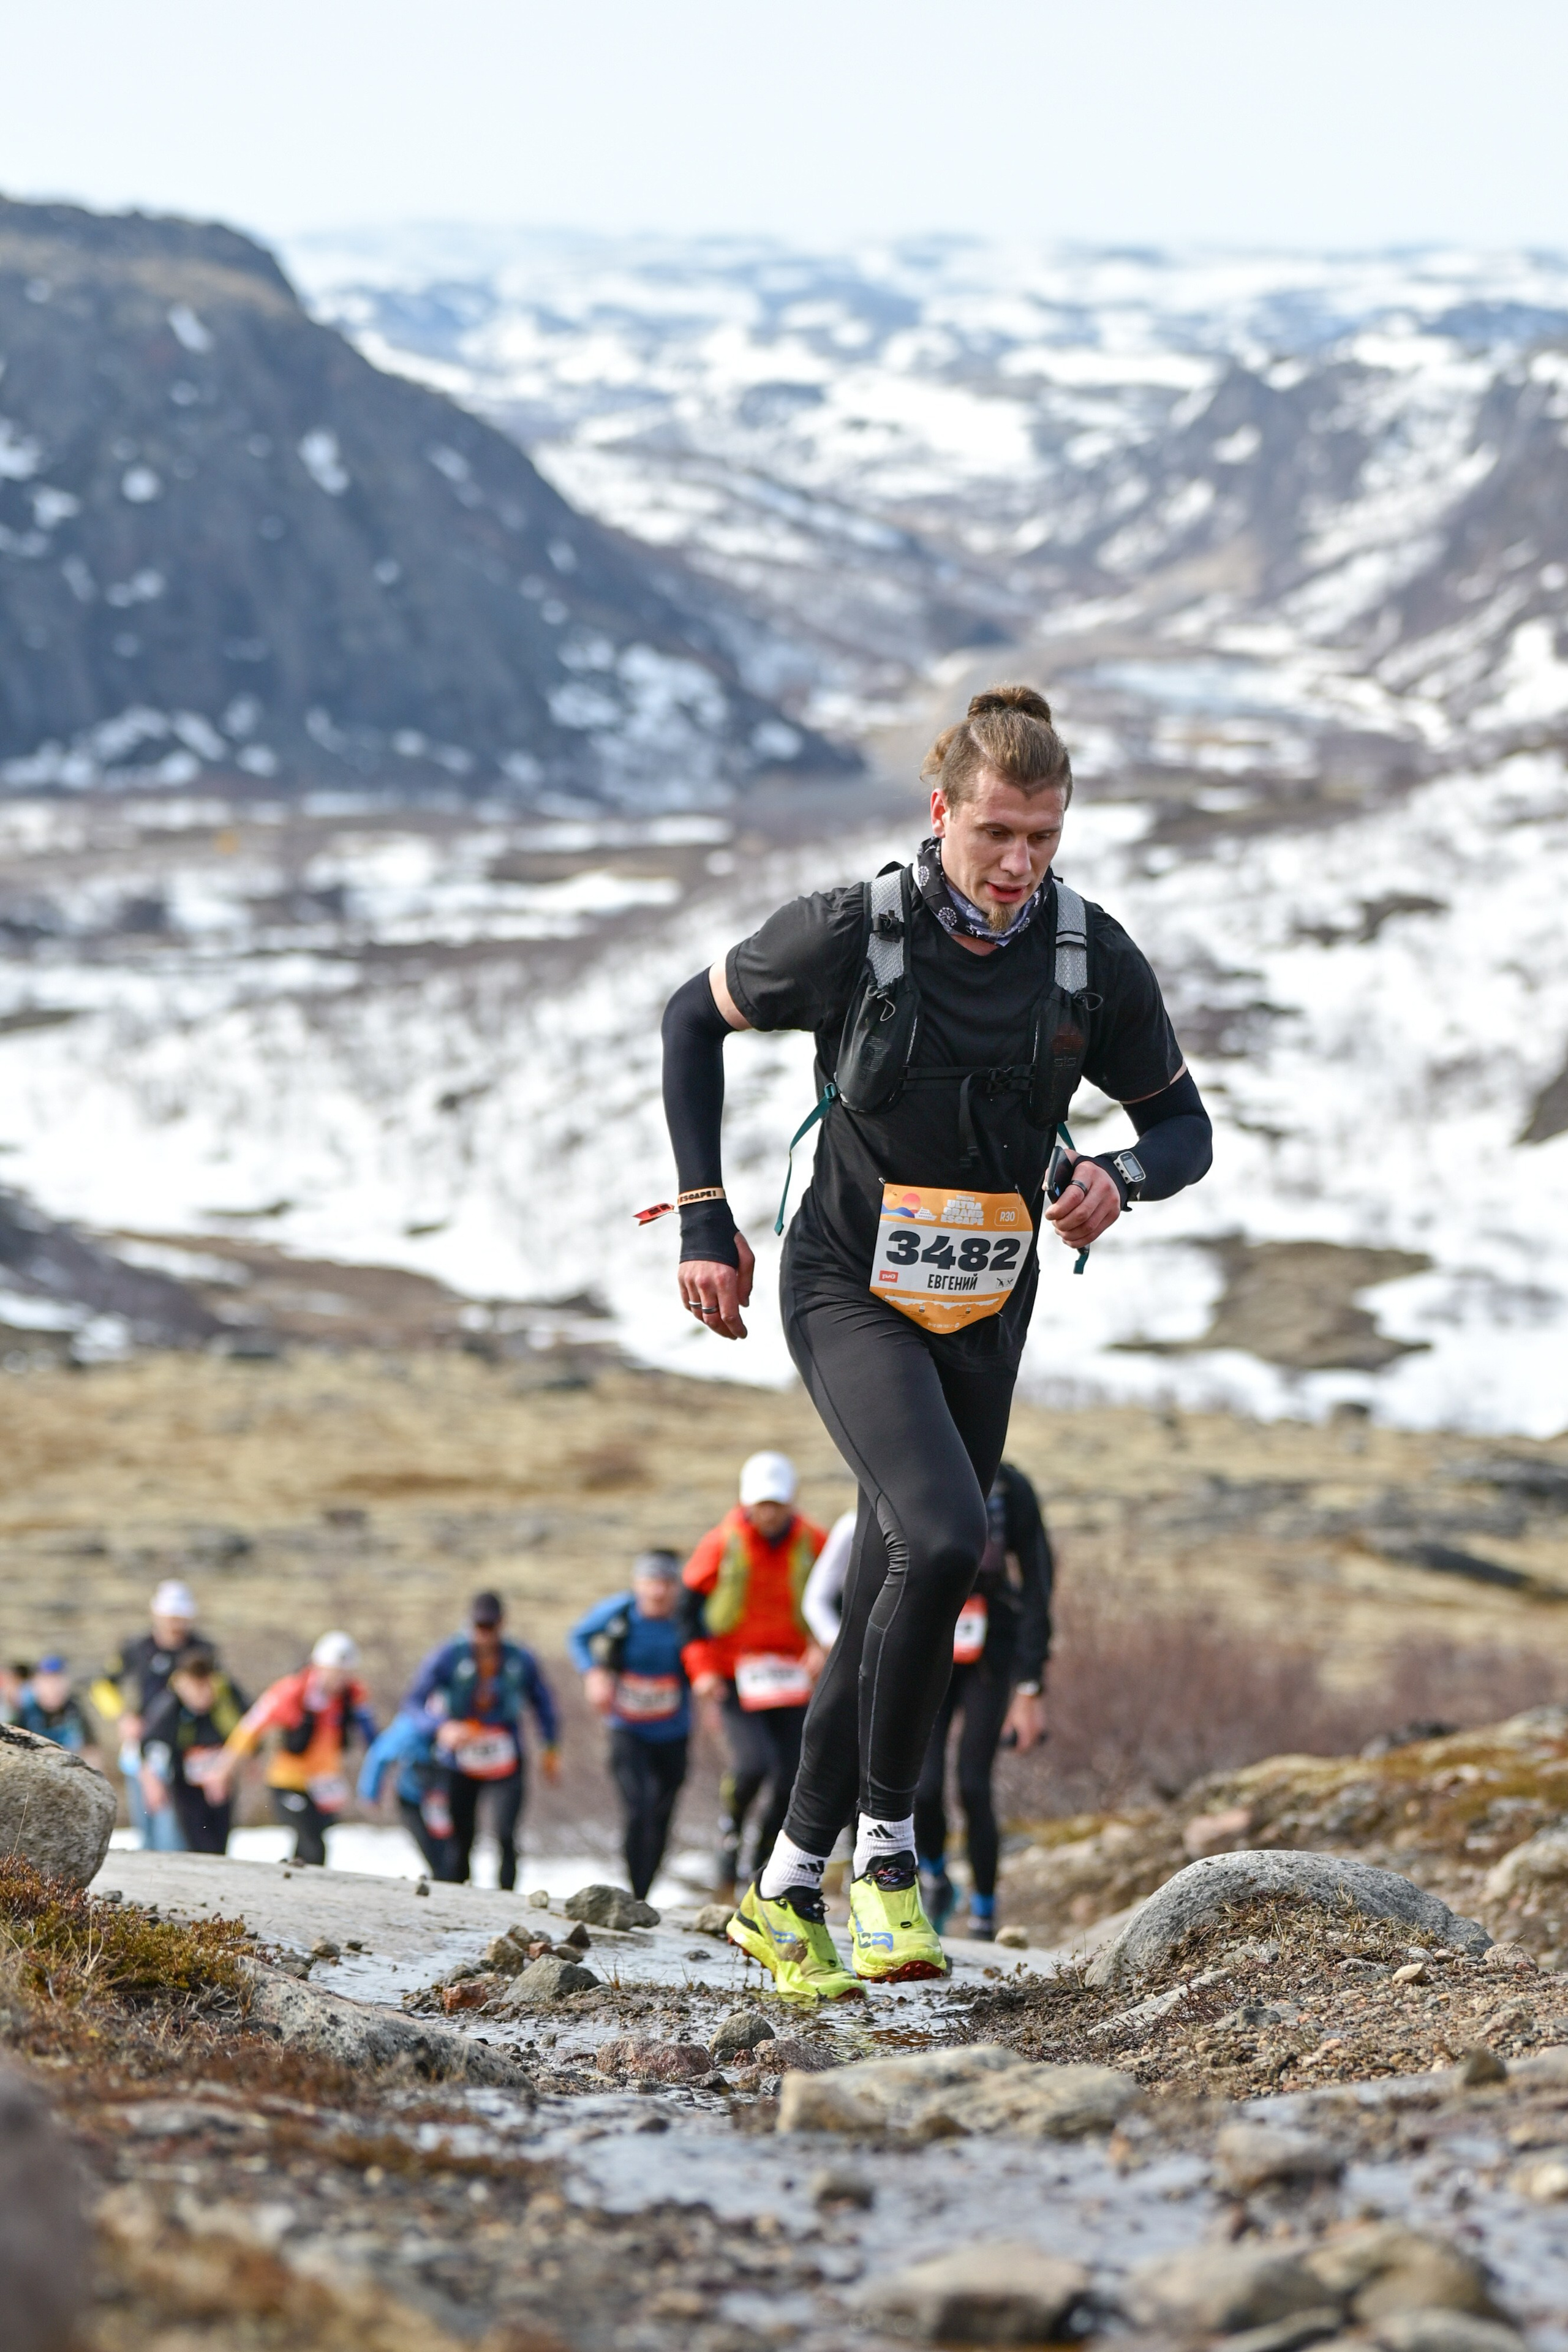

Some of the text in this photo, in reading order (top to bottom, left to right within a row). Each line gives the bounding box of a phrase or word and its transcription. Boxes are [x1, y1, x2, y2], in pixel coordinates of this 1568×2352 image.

[946, 1199, 982, 1210] ULTRA
[943, 1207, 984, 1218] GRAND
[1000, 1211, 1016, 1223] R30
[940, 1214, 984, 1226] ESCAPE
[886, 1230, 1020, 1272] 3482
[927, 1273, 978, 1291] ЕВГЕНИЙ
